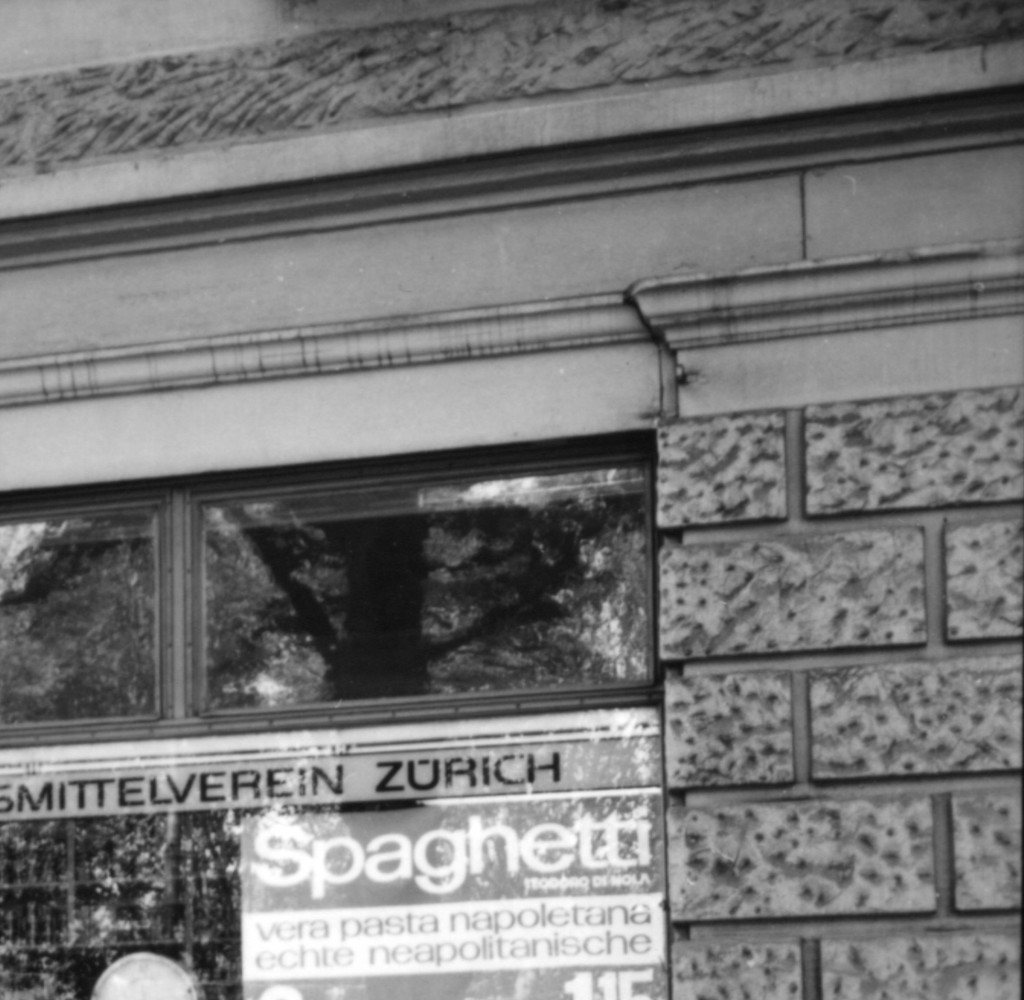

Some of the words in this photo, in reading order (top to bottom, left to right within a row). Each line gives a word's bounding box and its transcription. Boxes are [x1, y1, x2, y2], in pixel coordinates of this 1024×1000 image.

[376, 752, 561, 792] ZÜRICH
[251, 806, 653, 899] Spaghetti
[255, 918, 330, 942] vera
[340, 911, 441, 941] pasta
[450, 903, 652, 936] napoletana
[255, 944, 355, 971] echte
[369, 931, 652, 966] neapolitanische
